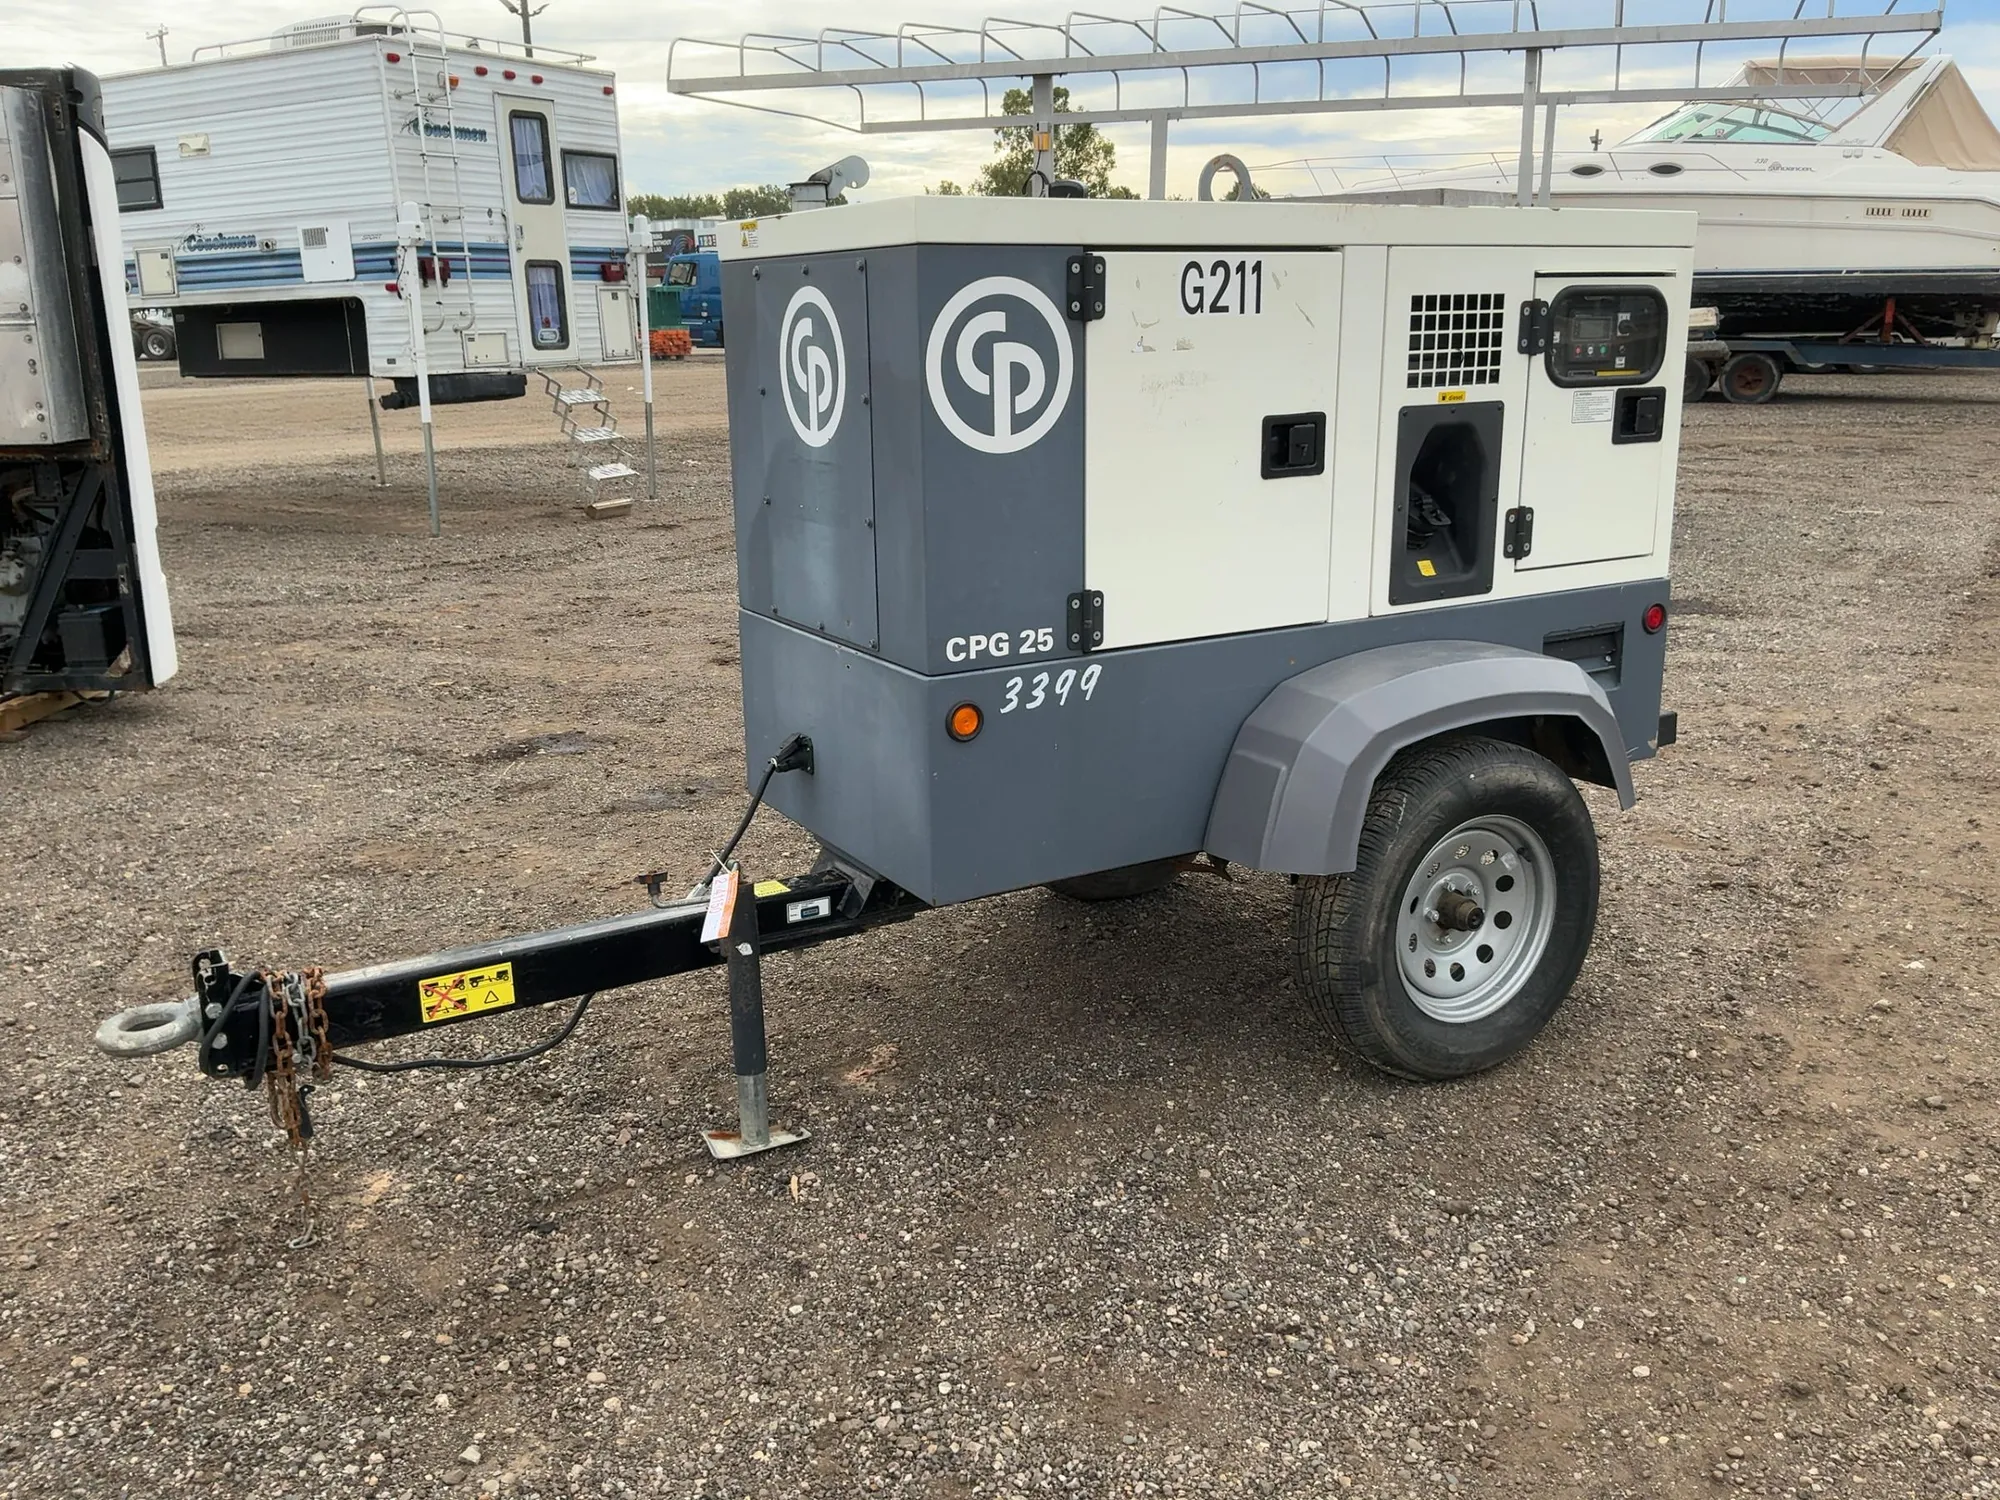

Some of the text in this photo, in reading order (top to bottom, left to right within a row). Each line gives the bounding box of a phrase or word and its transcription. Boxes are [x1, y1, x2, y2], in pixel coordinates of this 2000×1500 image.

[1181, 260, 1262, 315] G211
[946, 628, 1054, 662] CPG 25
[1000, 664, 1102, 714] 3399
